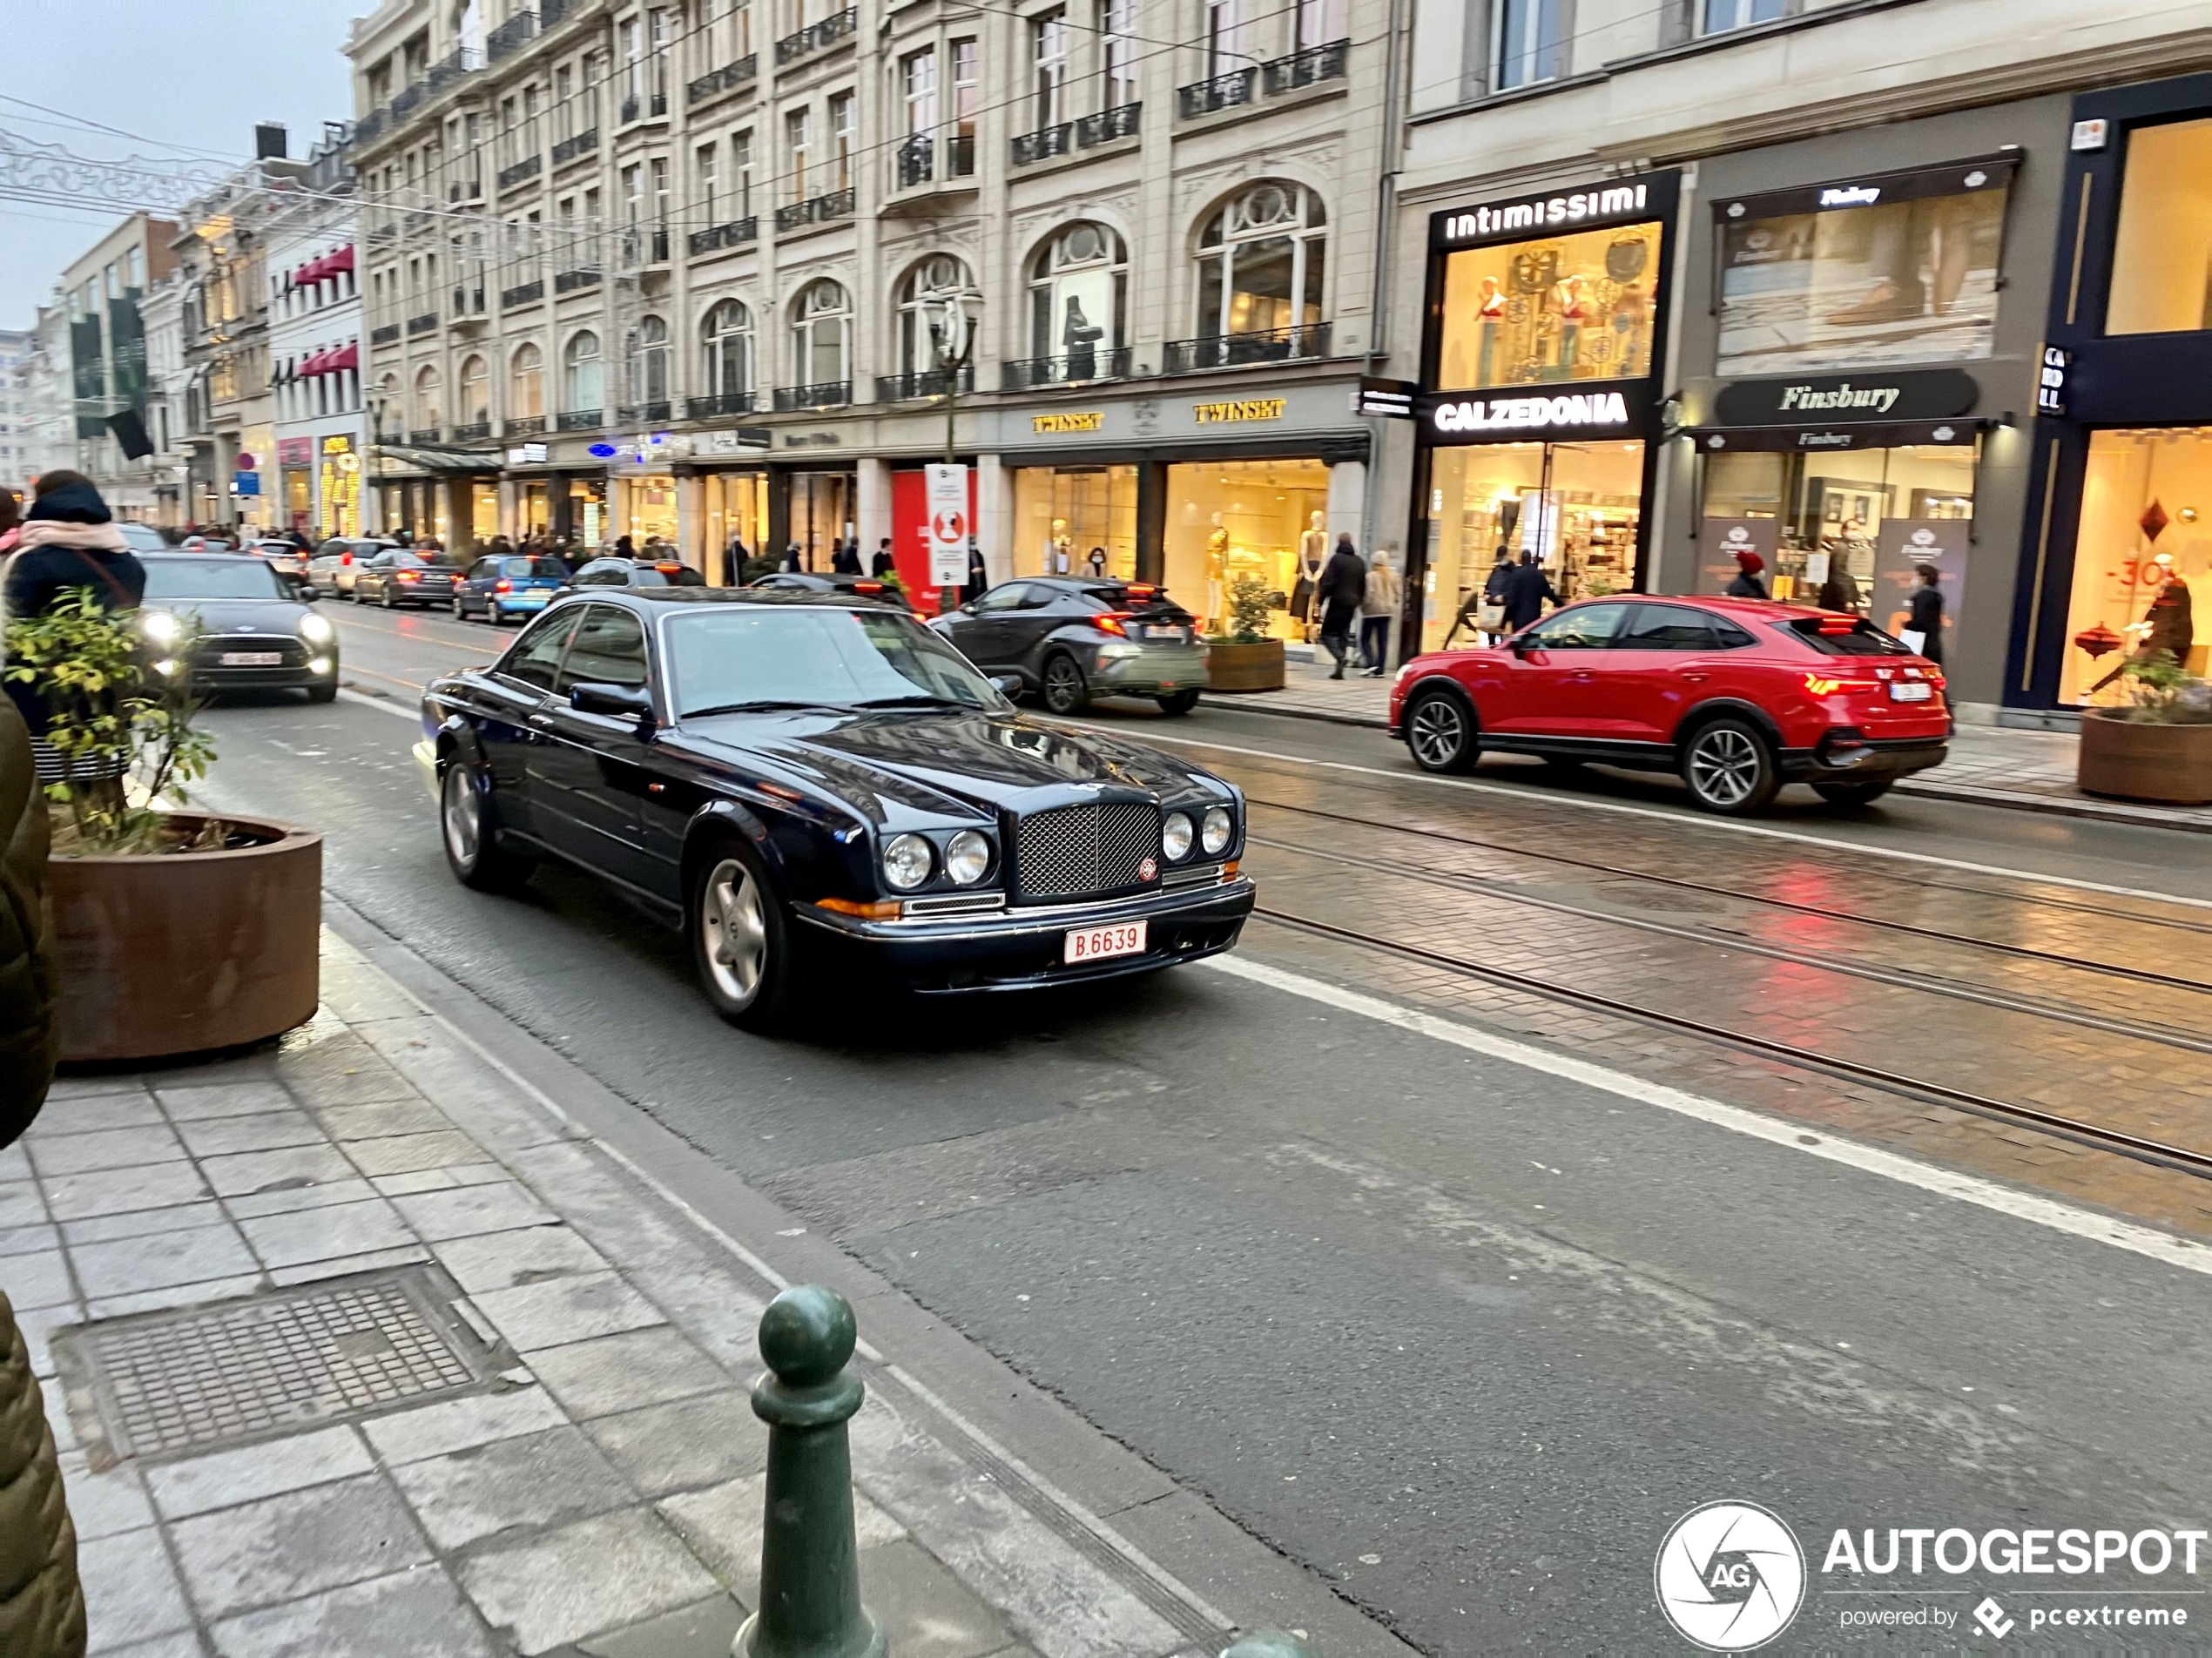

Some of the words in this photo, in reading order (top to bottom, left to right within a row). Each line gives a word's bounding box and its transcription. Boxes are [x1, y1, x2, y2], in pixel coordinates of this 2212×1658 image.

[1193, 399, 1287, 423] TWINSET
[1434, 392, 1629, 430] CALZEDONIA
[1777, 383, 1899, 413] Finsbury
[1031, 412, 1104, 433] TWINSET
